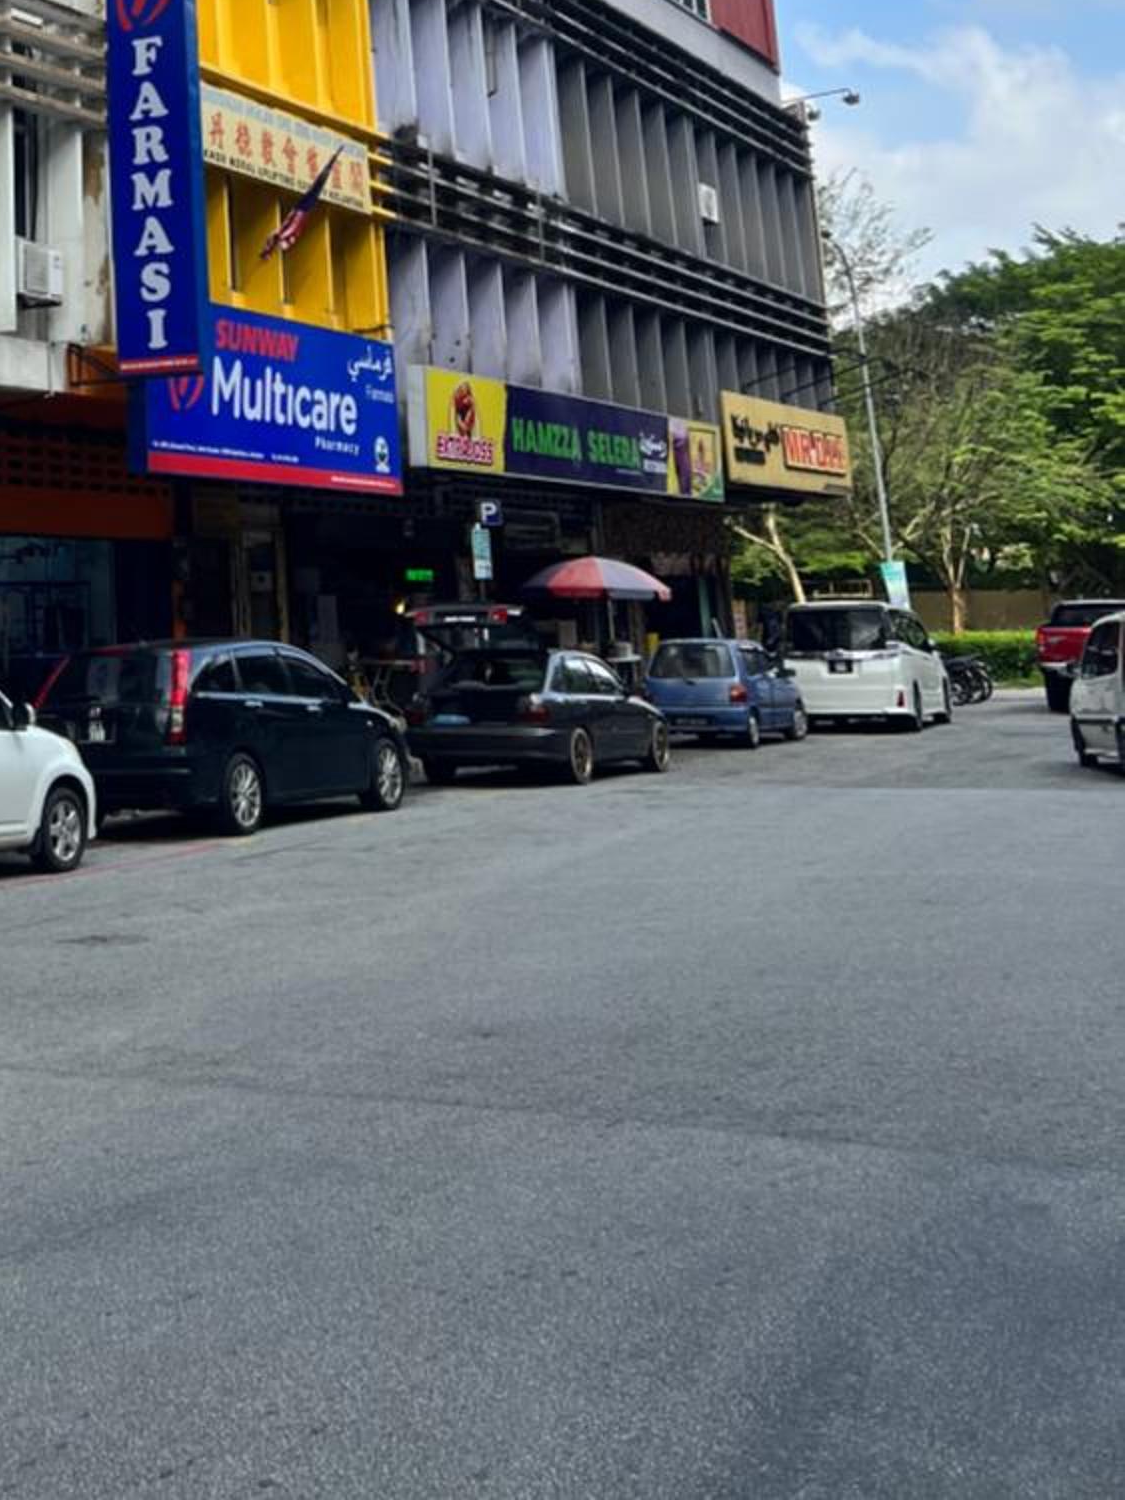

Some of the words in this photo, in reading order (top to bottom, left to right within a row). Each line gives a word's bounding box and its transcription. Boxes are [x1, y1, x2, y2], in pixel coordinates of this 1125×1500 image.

[130, 36, 175, 350] FARMASI
[215, 318, 299, 363] SUNWAY
[211, 355, 358, 436] Multicare
[481, 502, 497, 521] P
